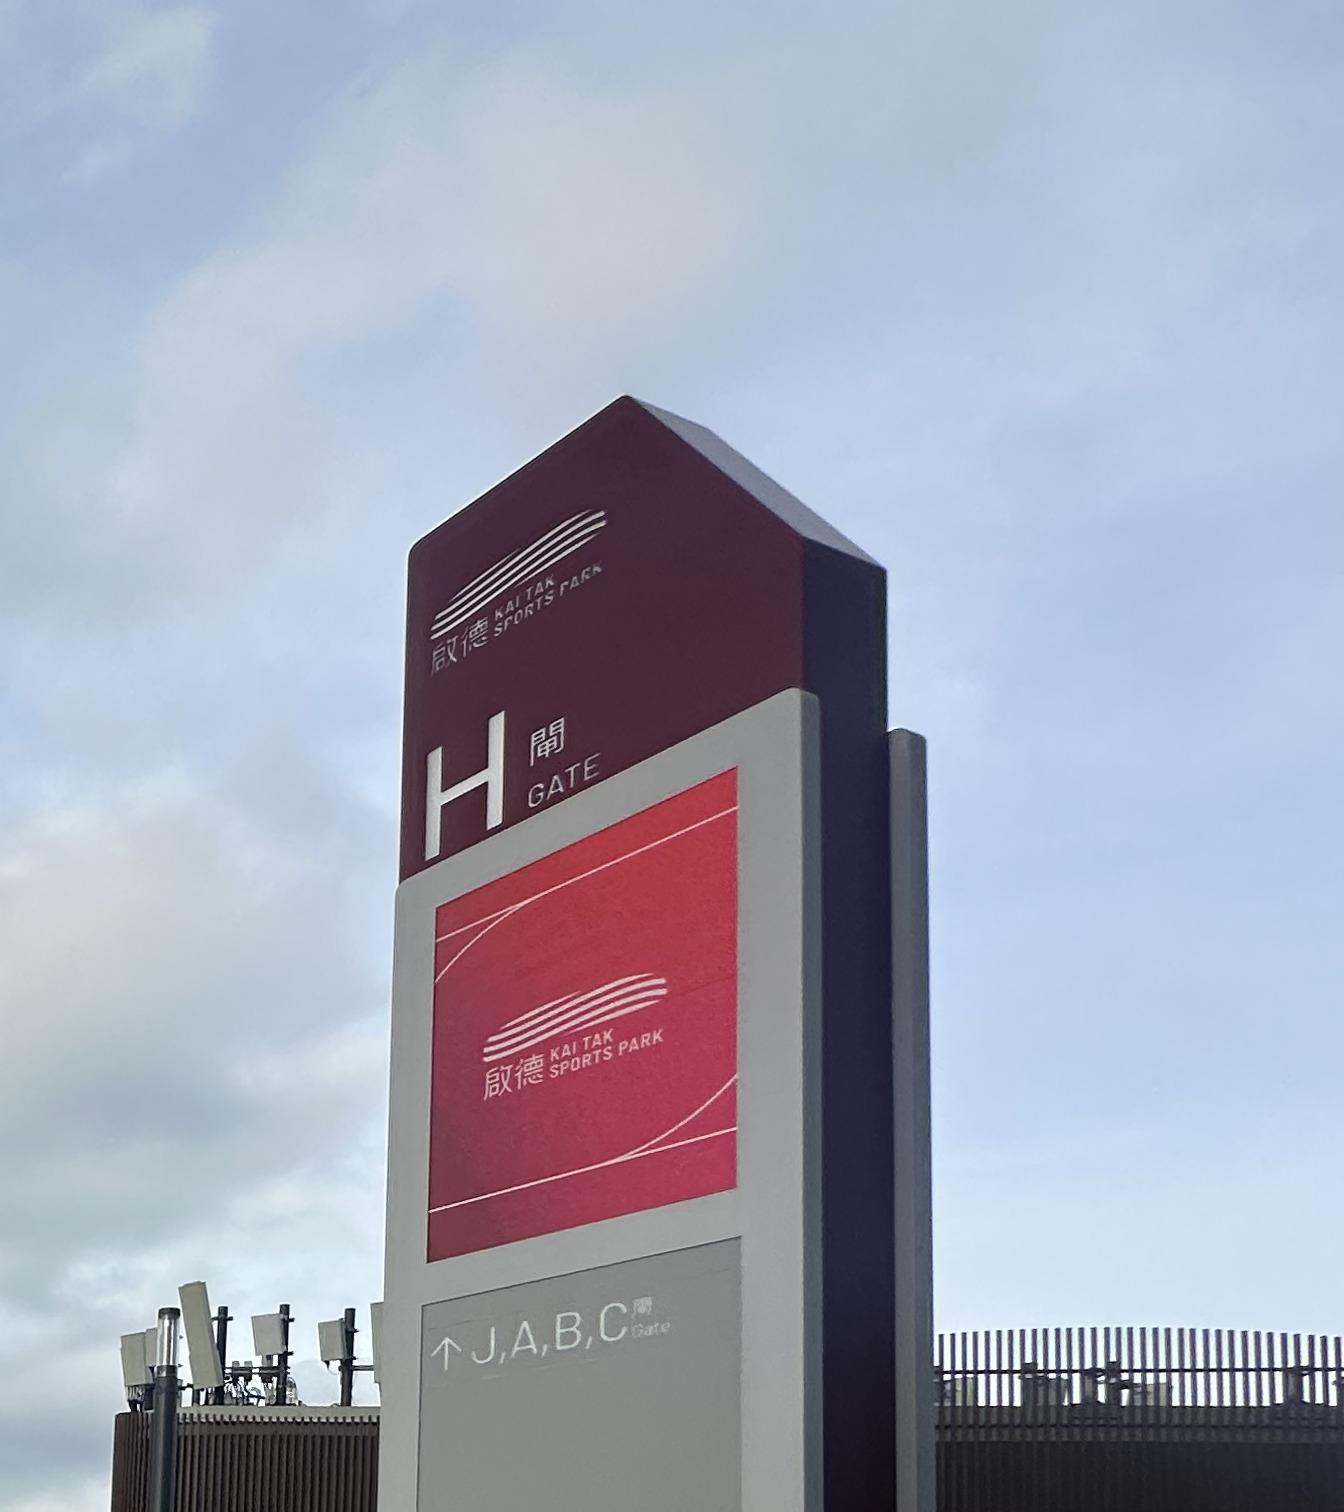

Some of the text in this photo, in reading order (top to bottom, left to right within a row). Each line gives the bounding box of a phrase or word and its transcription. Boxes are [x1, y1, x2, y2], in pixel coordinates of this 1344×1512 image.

[493, 561, 603, 637] SPORTS PARK
[494, 574, 555, 621] KAI TAK
[430, 616, 489, 676] 啟德
[529, 717, 565, 767] 閘
[425, 710, 505, 862] H
[527, 752, 601, 808] GATE
[548, 1028, 664, 1080] SPORTS PARK
[549, 1028, 614, 1063] KAI TAK
[483, 1053, 545, 1101] 啟德
[630, 1321, 671, 1338] Gate
